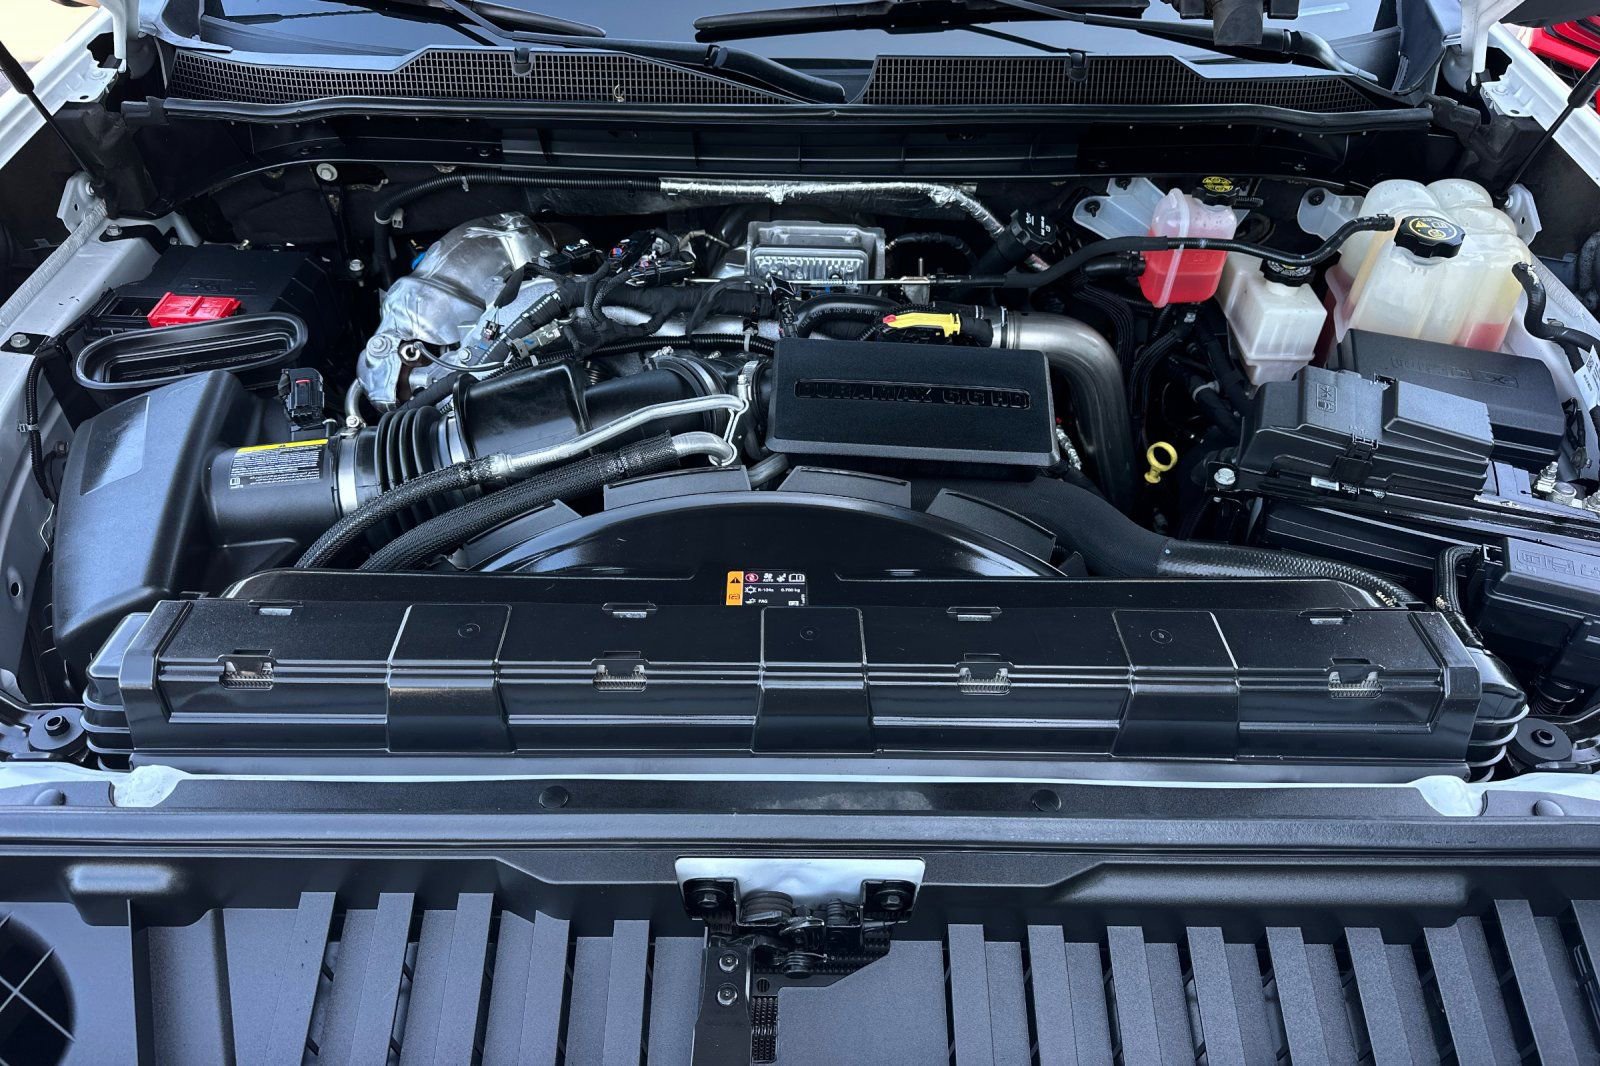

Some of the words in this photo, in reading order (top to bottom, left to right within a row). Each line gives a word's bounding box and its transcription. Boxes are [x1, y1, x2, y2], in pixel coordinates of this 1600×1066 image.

[796, 381, 933, 403] DURAMAX
[942, 388, 985, 406] 6.6
[990, 391, 1029, 408] HD
